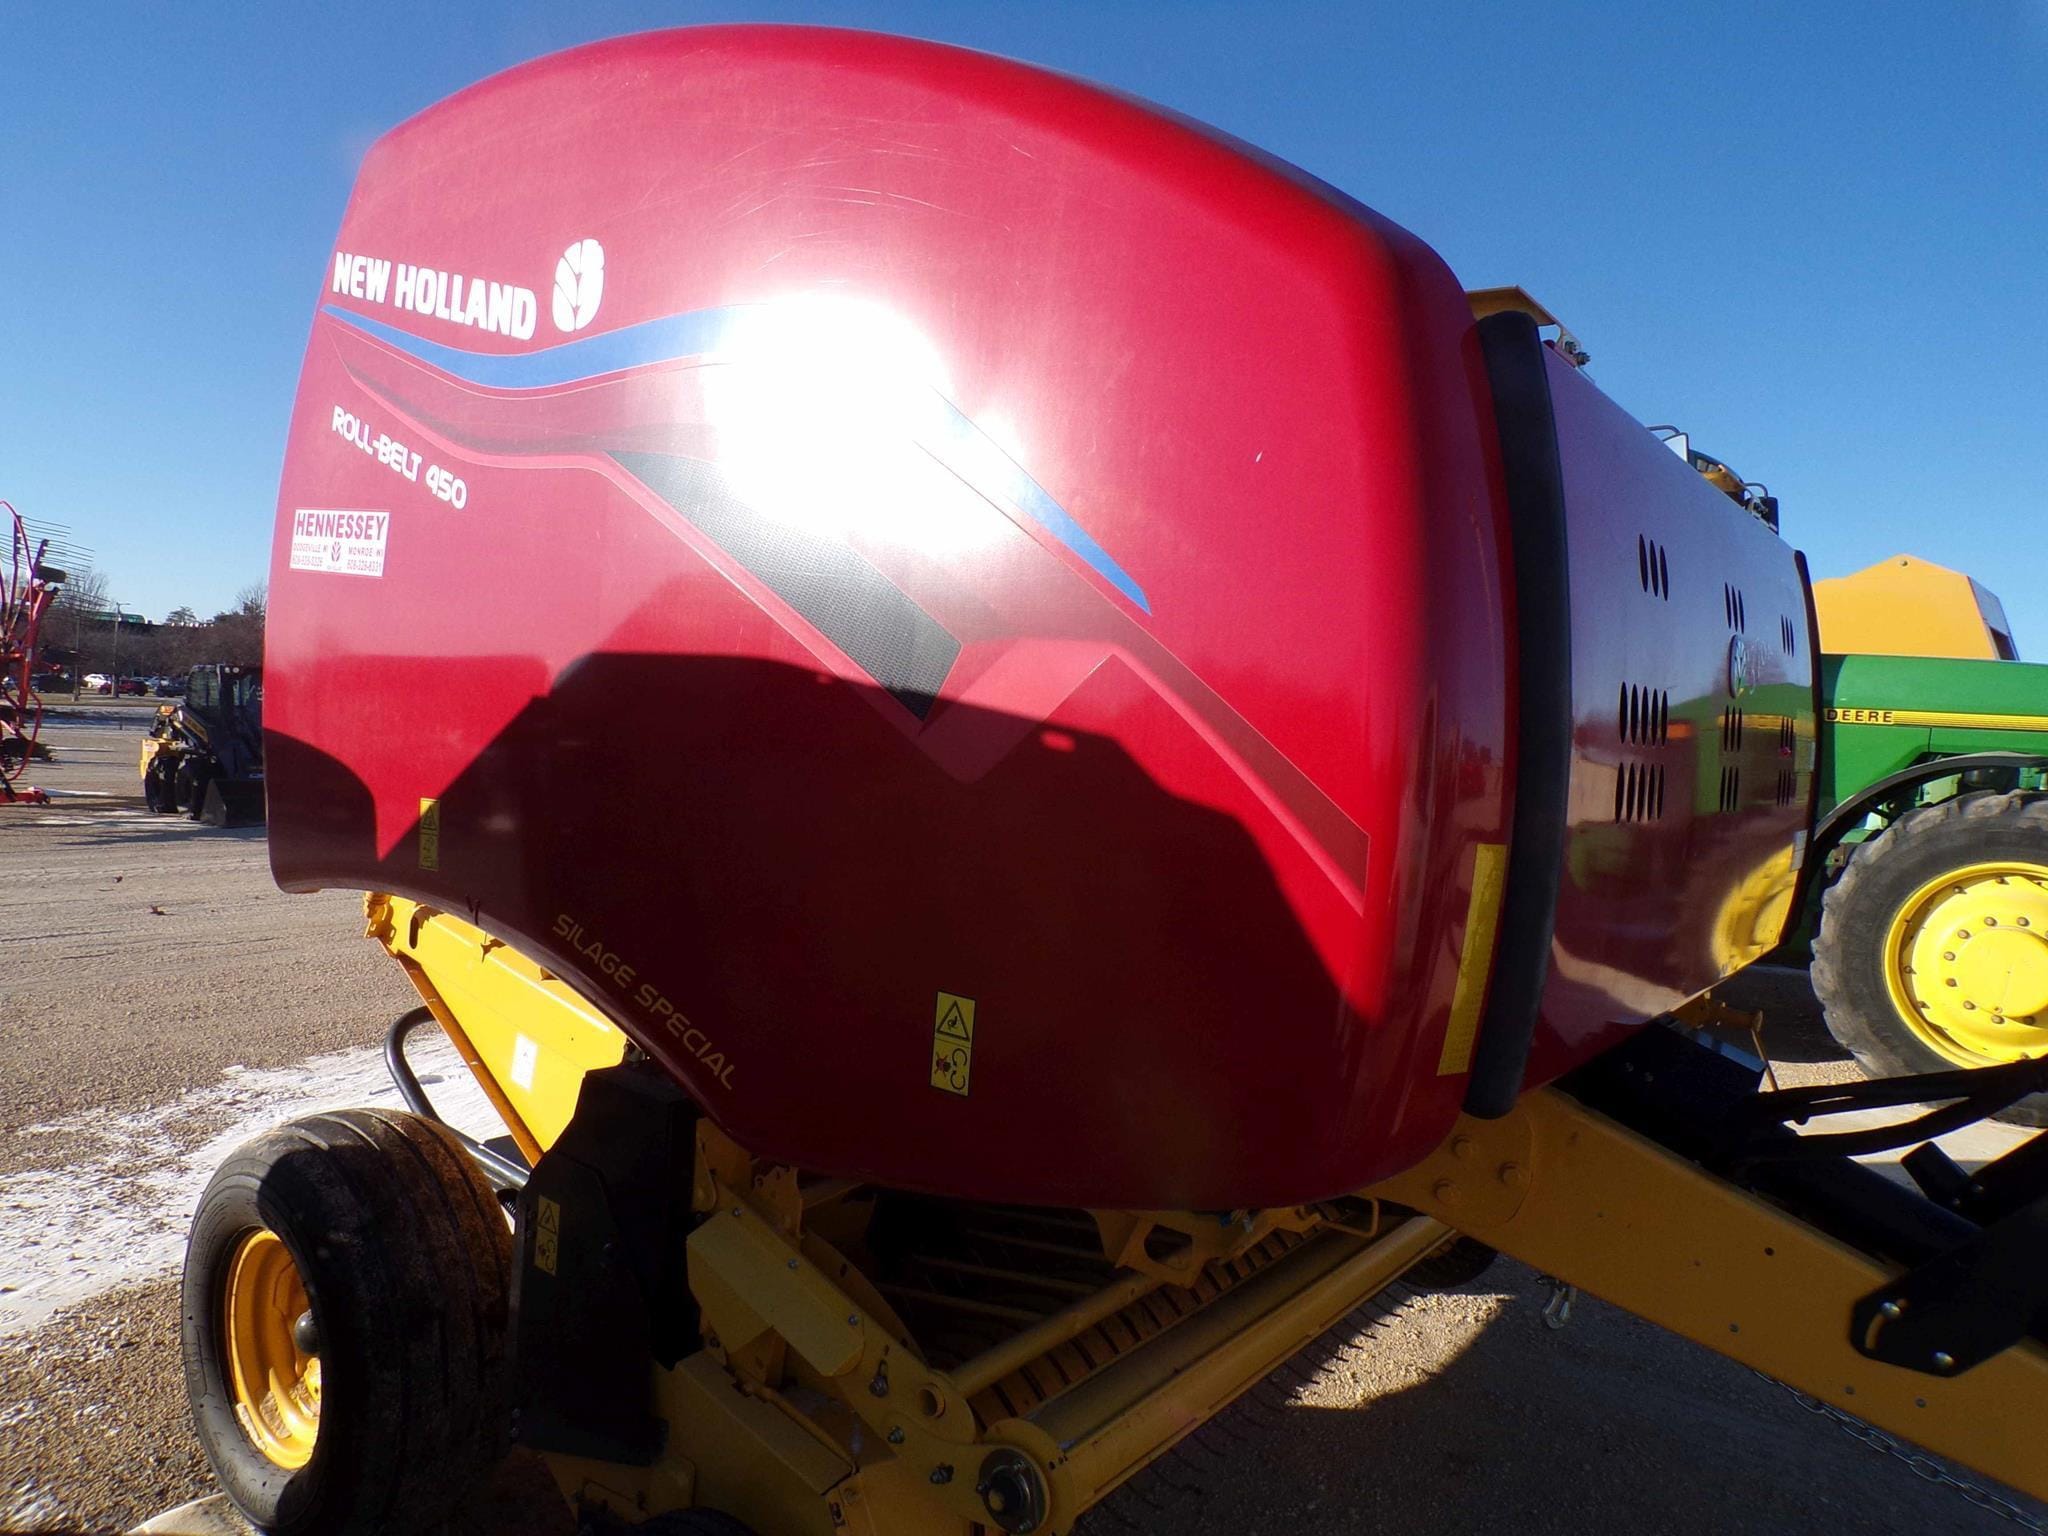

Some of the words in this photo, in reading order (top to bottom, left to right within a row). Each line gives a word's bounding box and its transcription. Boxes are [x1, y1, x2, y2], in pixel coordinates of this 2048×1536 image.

[332, 251, 391, 304] NEW
[394, 263, 537, 341] HOLLAND
[332, 405, 422, 482] ROLL-BELT
[425, 464, 467, 510] 450
[295, 513, 386, 541] HENNESSEY
[348, 546, 373, 557] MONROE
[1826, 709, 1893, 723] DEERE
[552, 914, 636, 988] SILAGE
[634, 983, 736, 1090] SPECIAL
